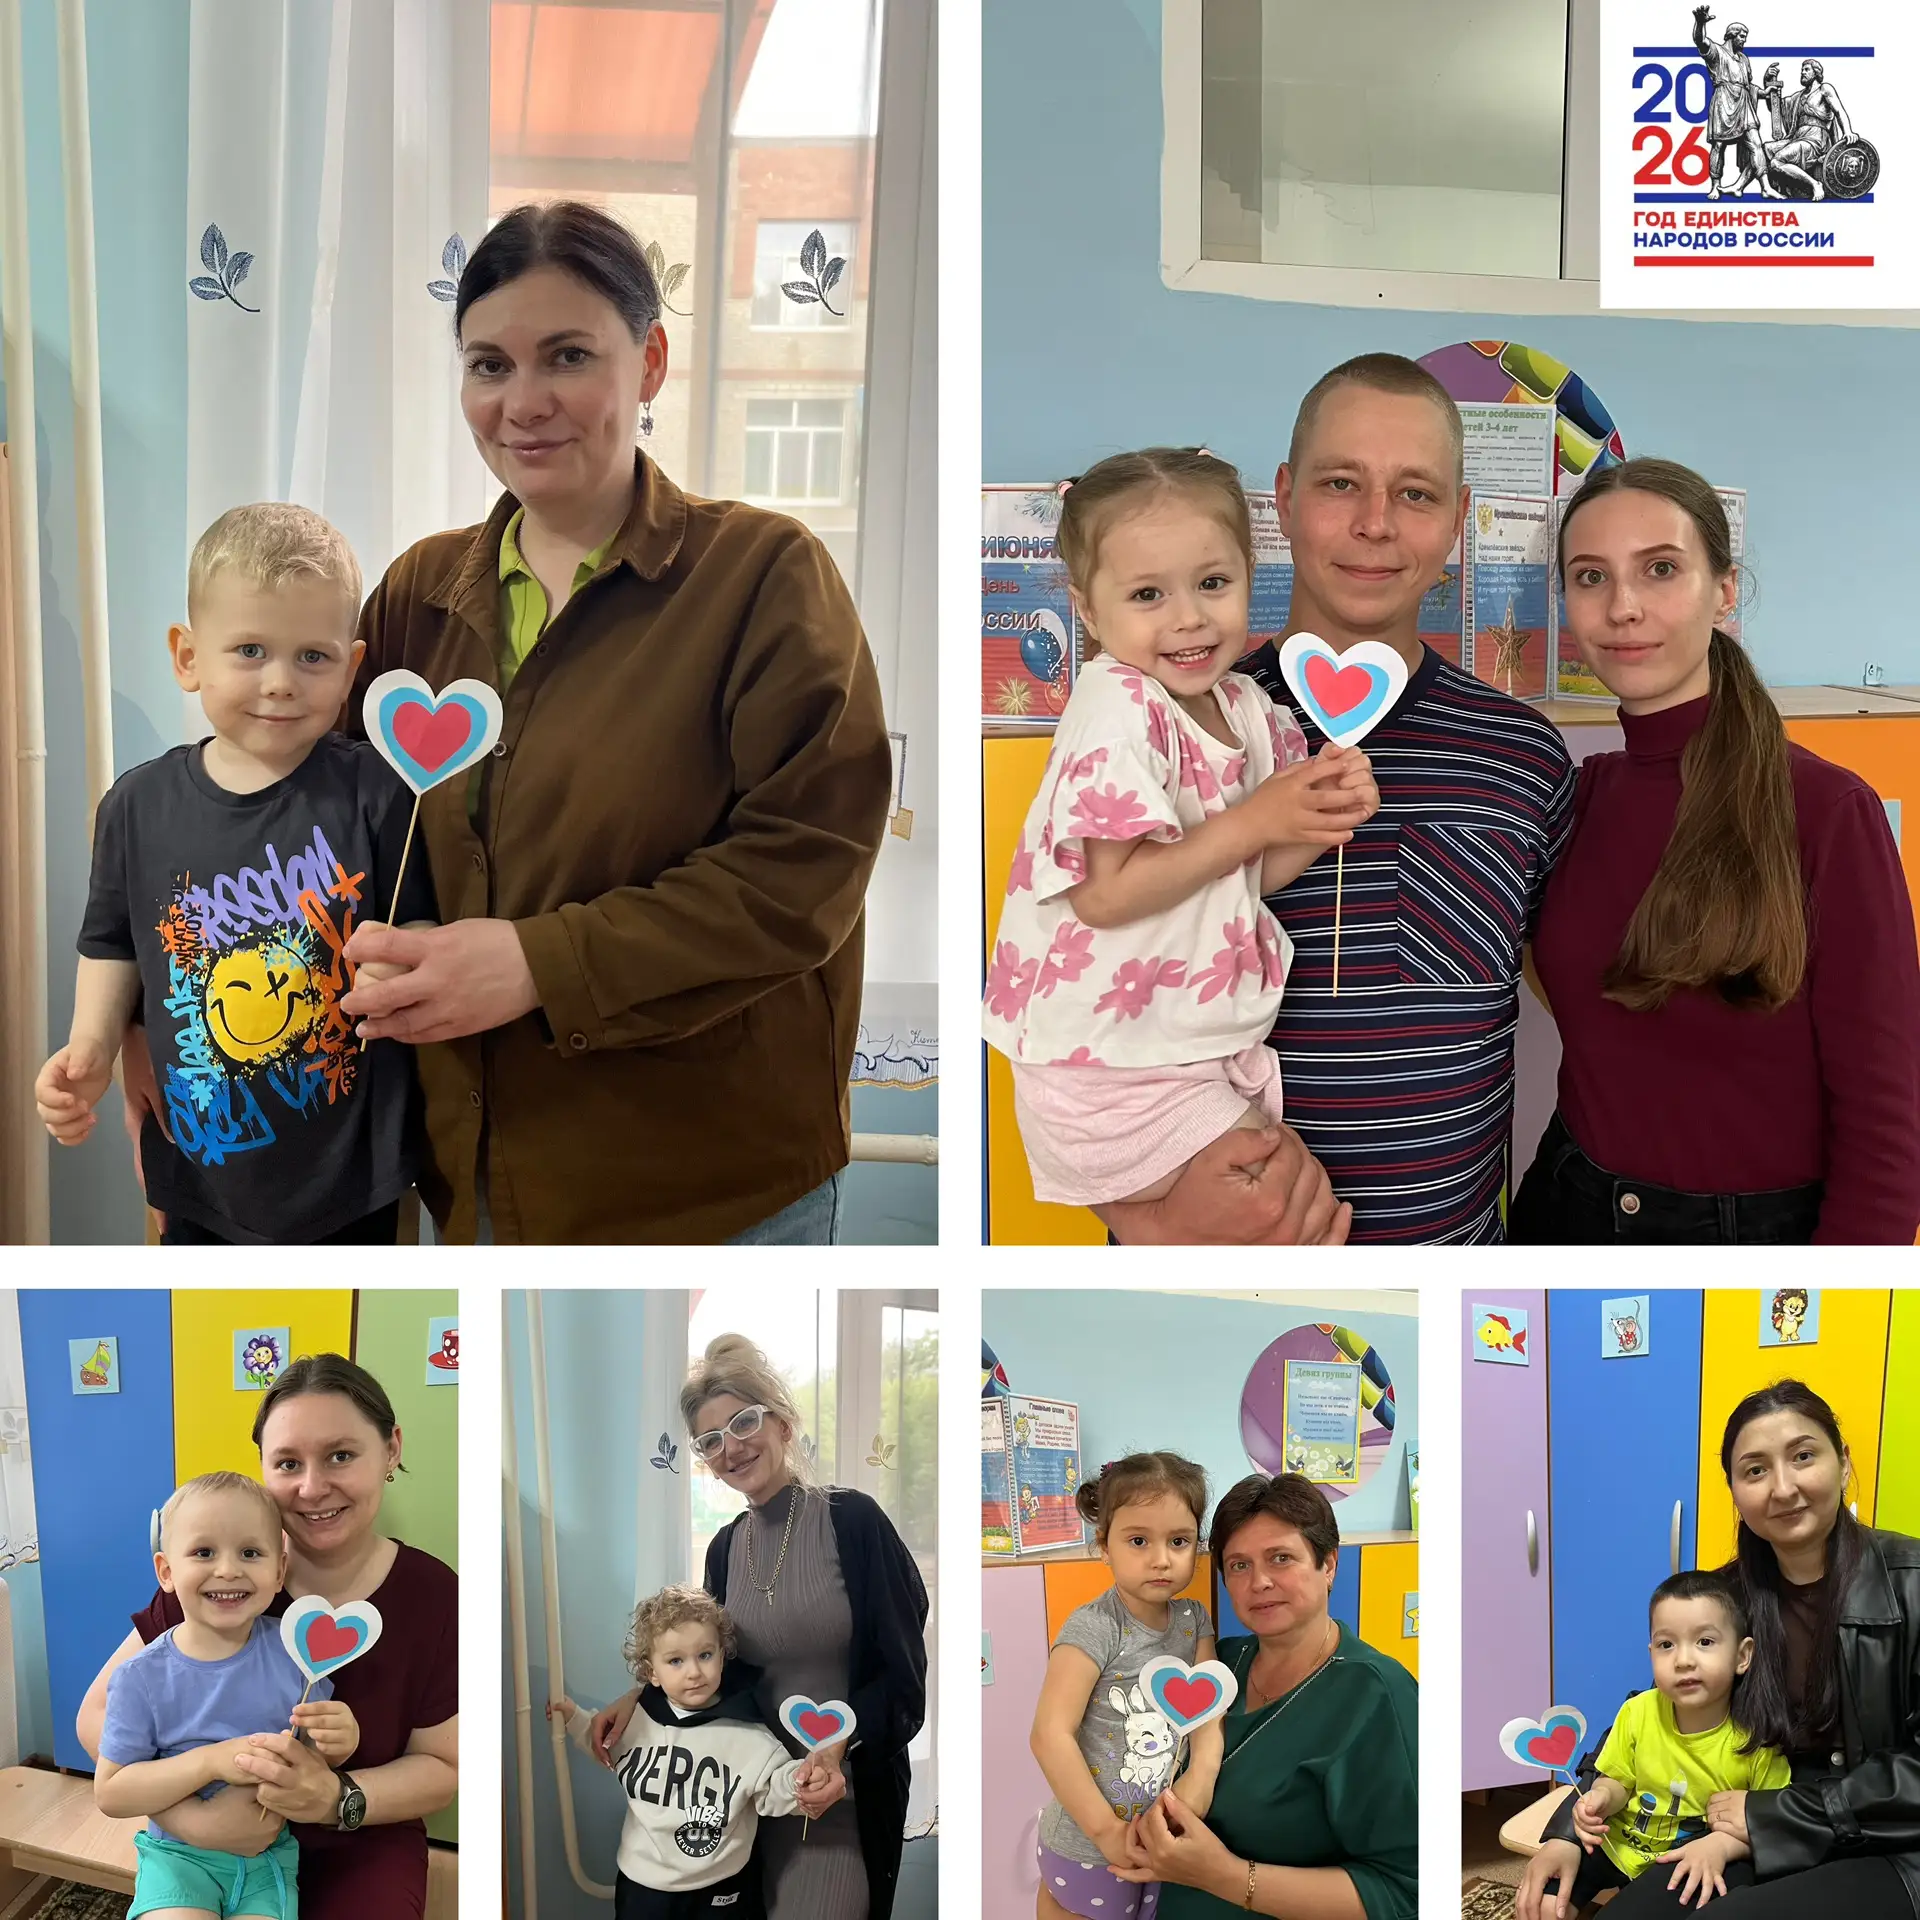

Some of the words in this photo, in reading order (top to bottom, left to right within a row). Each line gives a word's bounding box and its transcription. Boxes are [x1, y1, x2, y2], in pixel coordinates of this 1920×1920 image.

[1488, 409, 1547, 420] особенности
[1485, 423, 1501, 432] 3-4
[982, 536, 1055, 558] ИЮНЯ
[982, 612, 1041, 630] ССИИ
[1295, 1368, 1320, 1378] Девиз
[1322, 1371, 1352, 1380] группы
[614, 1745, 741, 1828] NERGY
[676, 1834, 695, 1855] NEVER
[699, 1833, 720, 1855] SETTLE
